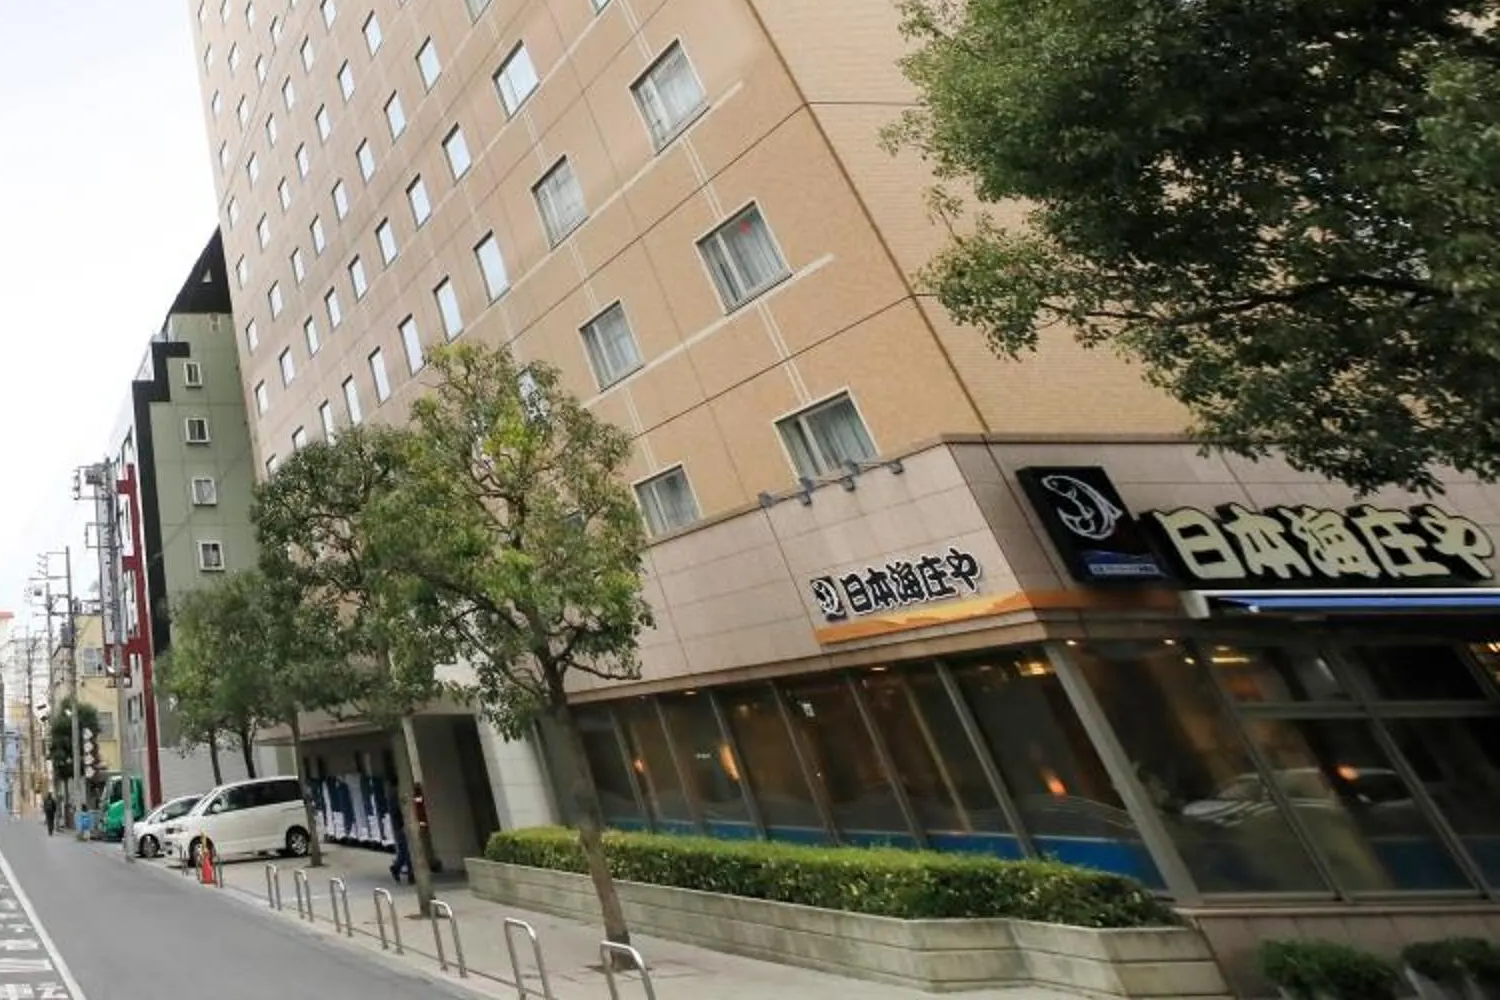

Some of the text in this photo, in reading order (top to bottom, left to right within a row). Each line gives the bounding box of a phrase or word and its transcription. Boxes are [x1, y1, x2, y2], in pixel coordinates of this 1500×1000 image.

[1150, 502, 1495, 579] 日本海庄や
[839, 546, 982, 614] 日本海庄や
